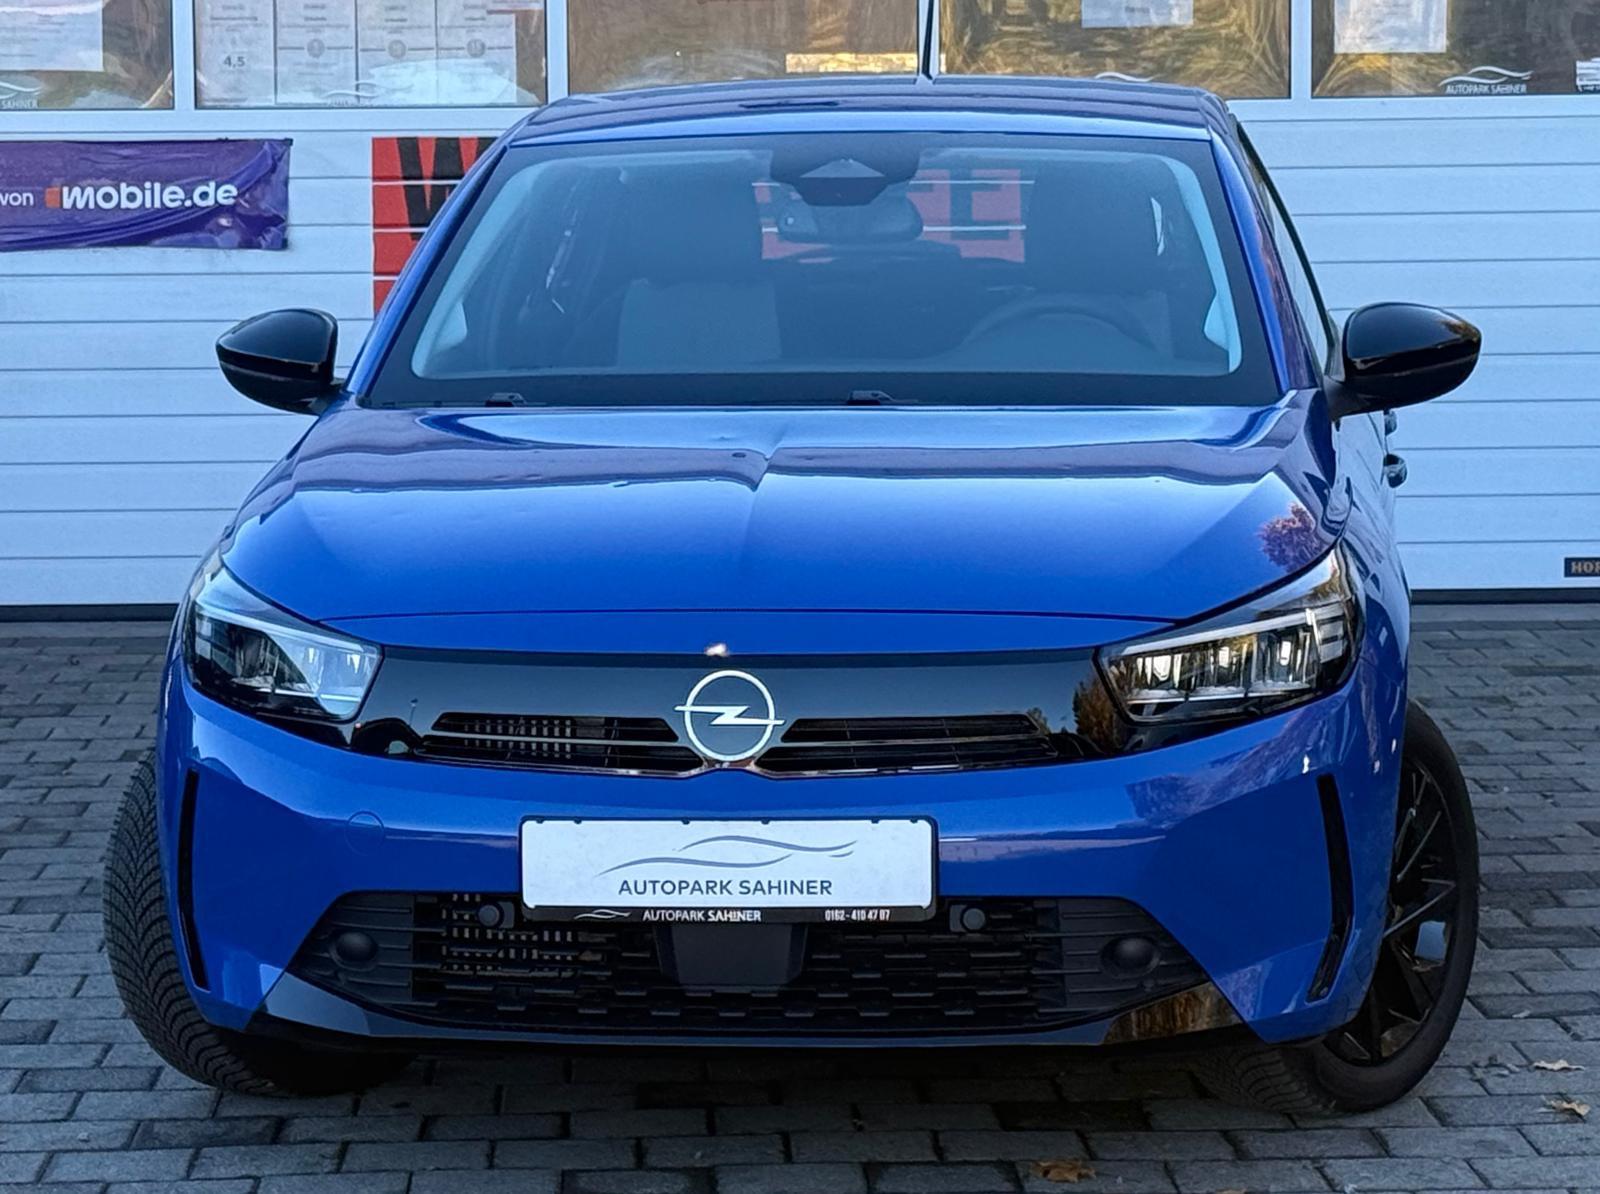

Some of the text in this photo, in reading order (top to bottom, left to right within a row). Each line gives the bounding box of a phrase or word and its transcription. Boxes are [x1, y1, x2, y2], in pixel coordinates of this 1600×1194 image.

[61, 181, 239, 210] mobile.de
[618, 879, 833, 896] AUTOPARK SAHINER
[642, 909, 762, 922] AUTOPARK SAHINER
